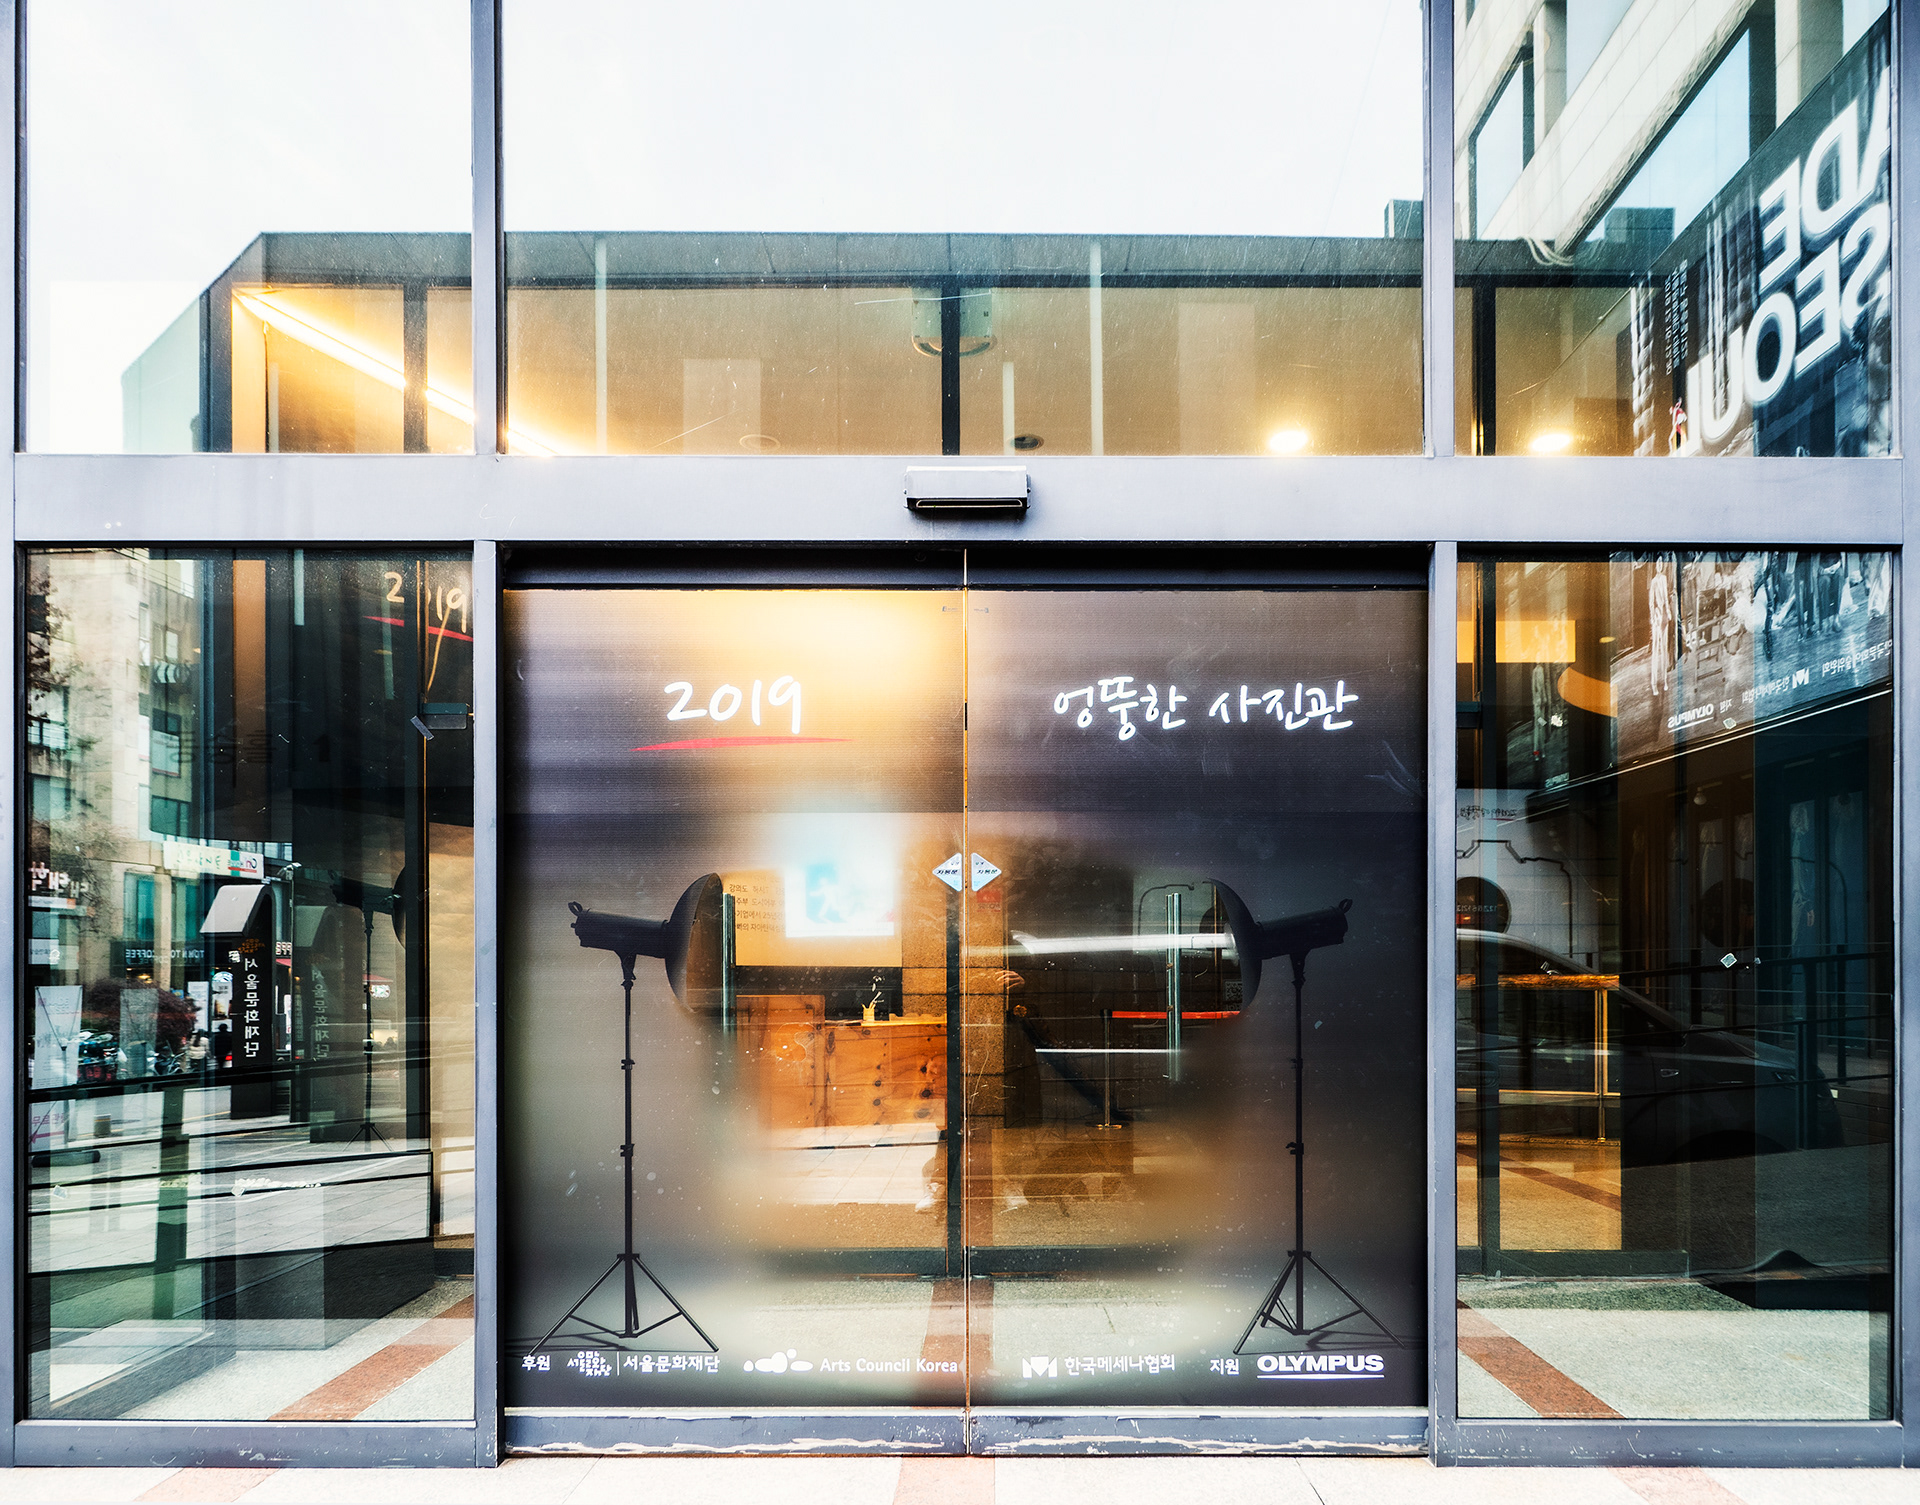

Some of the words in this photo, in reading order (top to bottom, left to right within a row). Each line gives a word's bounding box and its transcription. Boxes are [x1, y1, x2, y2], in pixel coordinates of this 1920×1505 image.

[664, 675, 802, 735] 2019
[1053, 676, 1188, 741] 엉뚱한
[1208, 680, 1359, 732] 사진관
[521, 1355, 551, 1371] 후원
[623, 1354, 721, 1373] 서울문화재단
[820, 1358, 851, 1373] Arts
[856, 1358, 911, 1373] Council
[916, 1358, 958, 1373] Korea
[1064, 1354, 1175, 1375] 한국메세나협회
[1209, 1358, 1240, 1375] 지원
[1256, 1354, 1385, 1372] OLYMPUS
